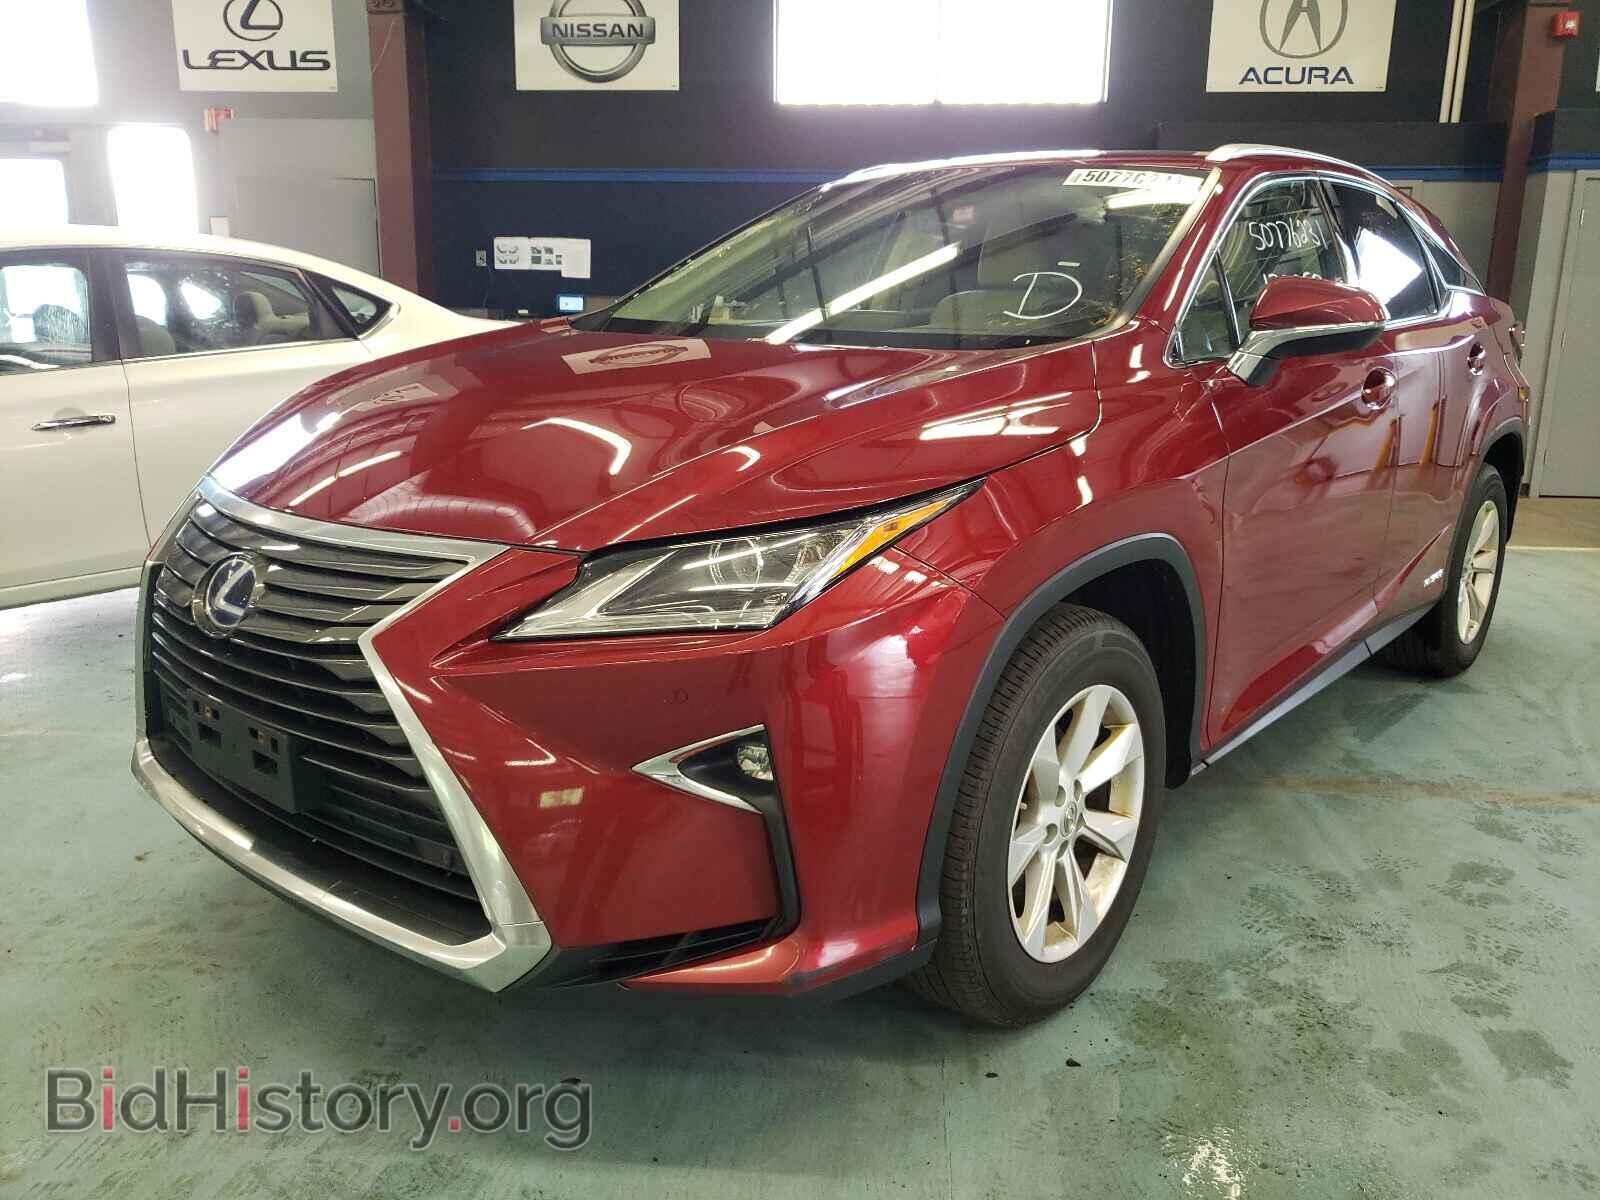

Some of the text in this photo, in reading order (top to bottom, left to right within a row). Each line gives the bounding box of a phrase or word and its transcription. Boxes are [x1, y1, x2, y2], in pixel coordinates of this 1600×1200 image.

[552, 23, 645, 38] NISSAN
[182, 49, 331, 71] LEXUS
[1238, 66, 1354, 85] ACURA
[1248, 217, 1329, 251] 50776231
